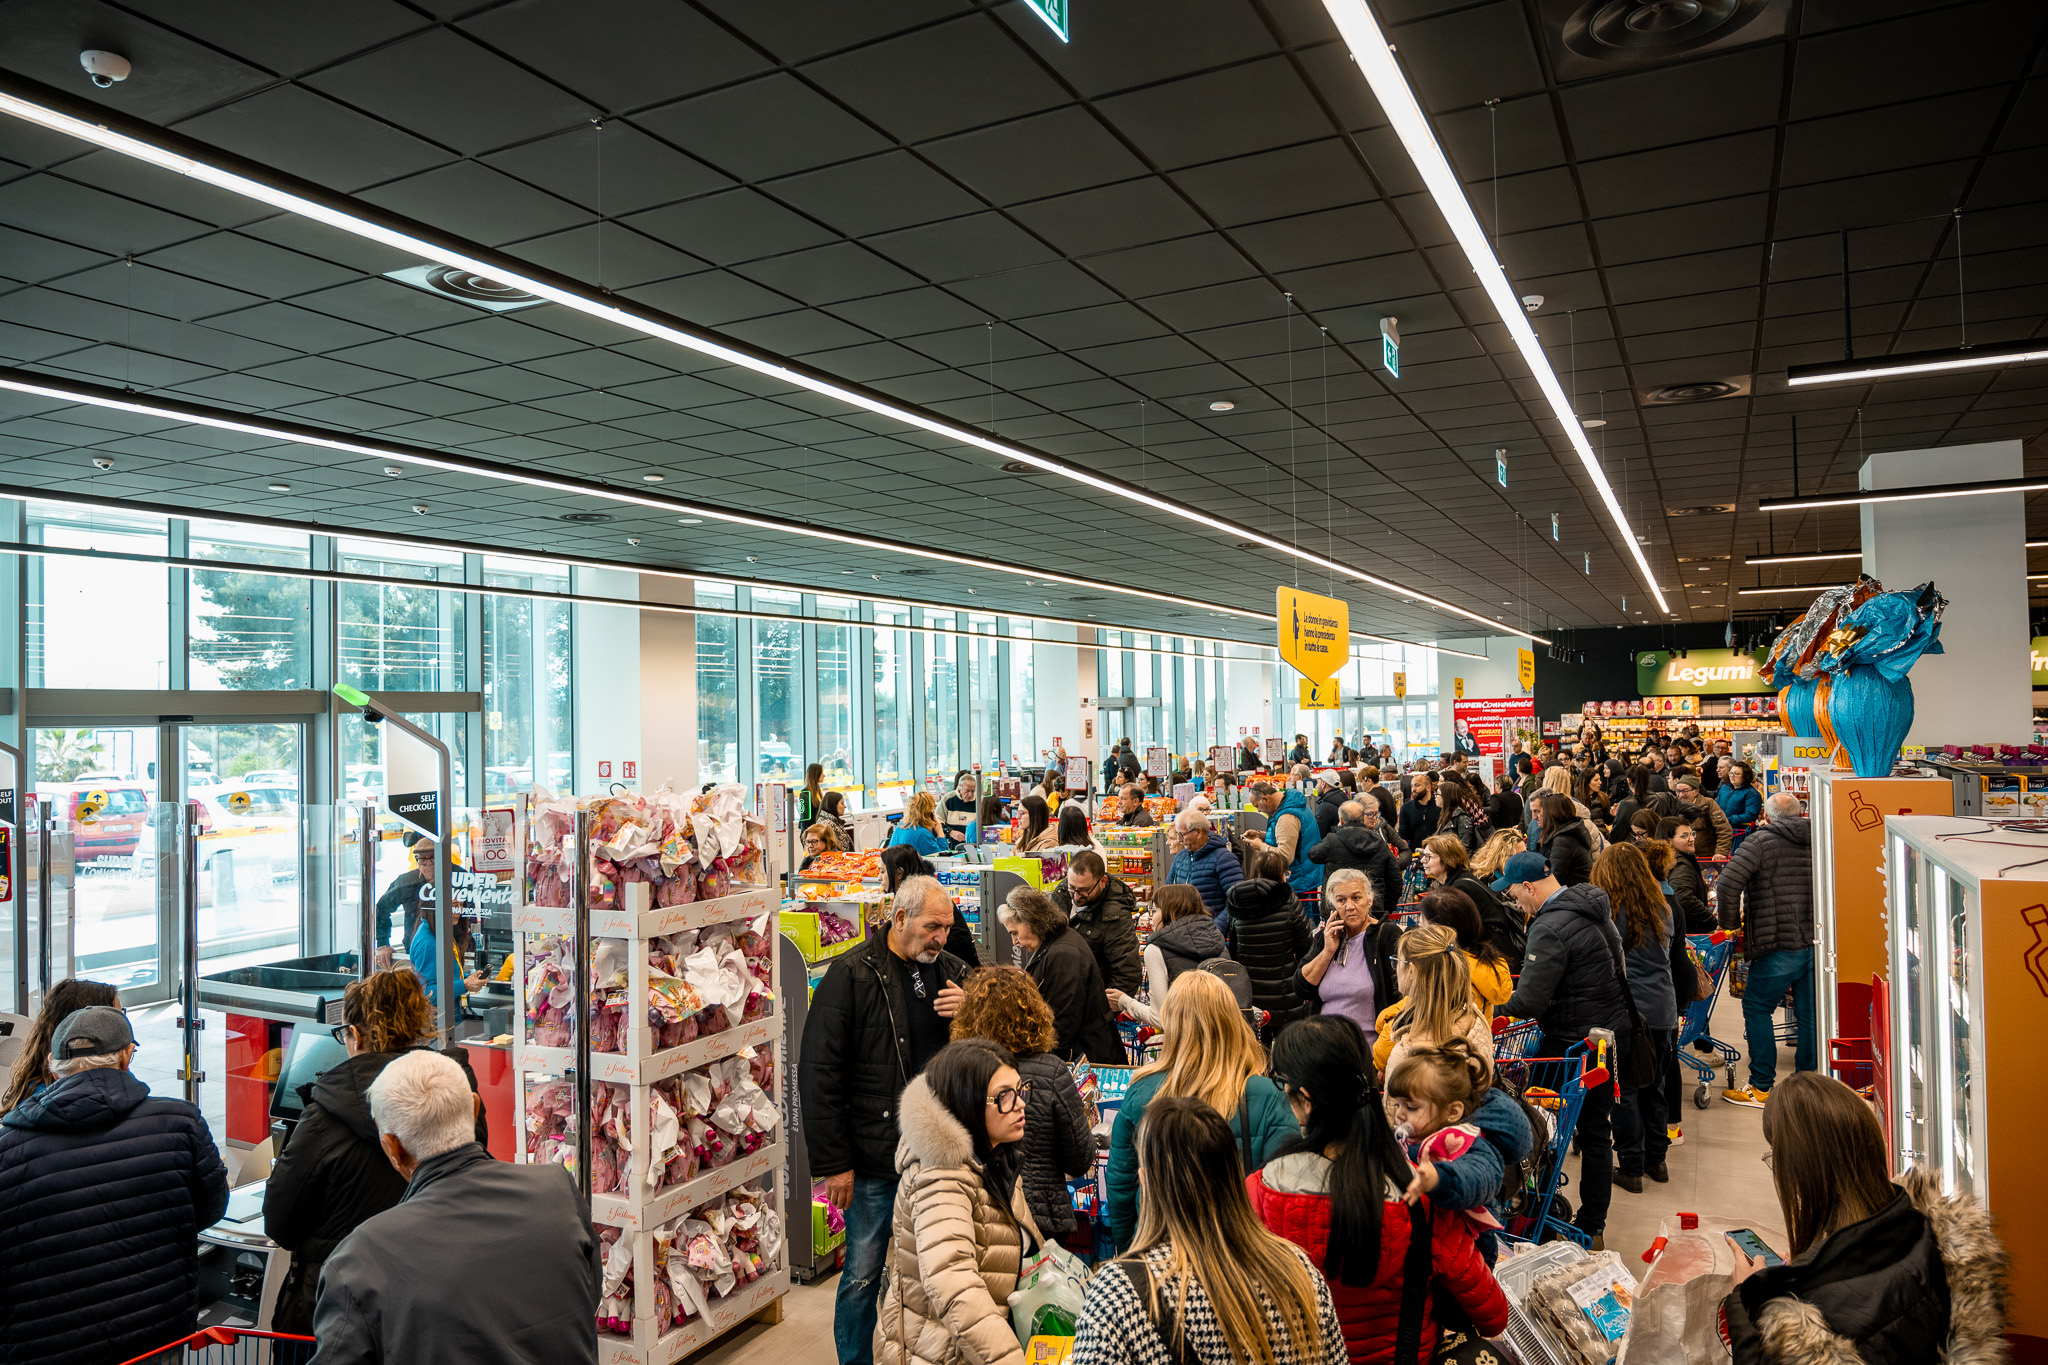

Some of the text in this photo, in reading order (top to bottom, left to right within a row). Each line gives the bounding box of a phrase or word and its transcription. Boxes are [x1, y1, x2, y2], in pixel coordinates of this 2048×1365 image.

[2031, 650, 2048, 671] fr
[1667, 659, 1755, 687] Legumi
[0, 790, 12, 798] ELF
[421, 794, 436, 803] SELF
[399, 802, 436, 813] CHECKOUT
[451, 872, 497, 889] UPER
[419, 882, 521, 905] Coveniente
